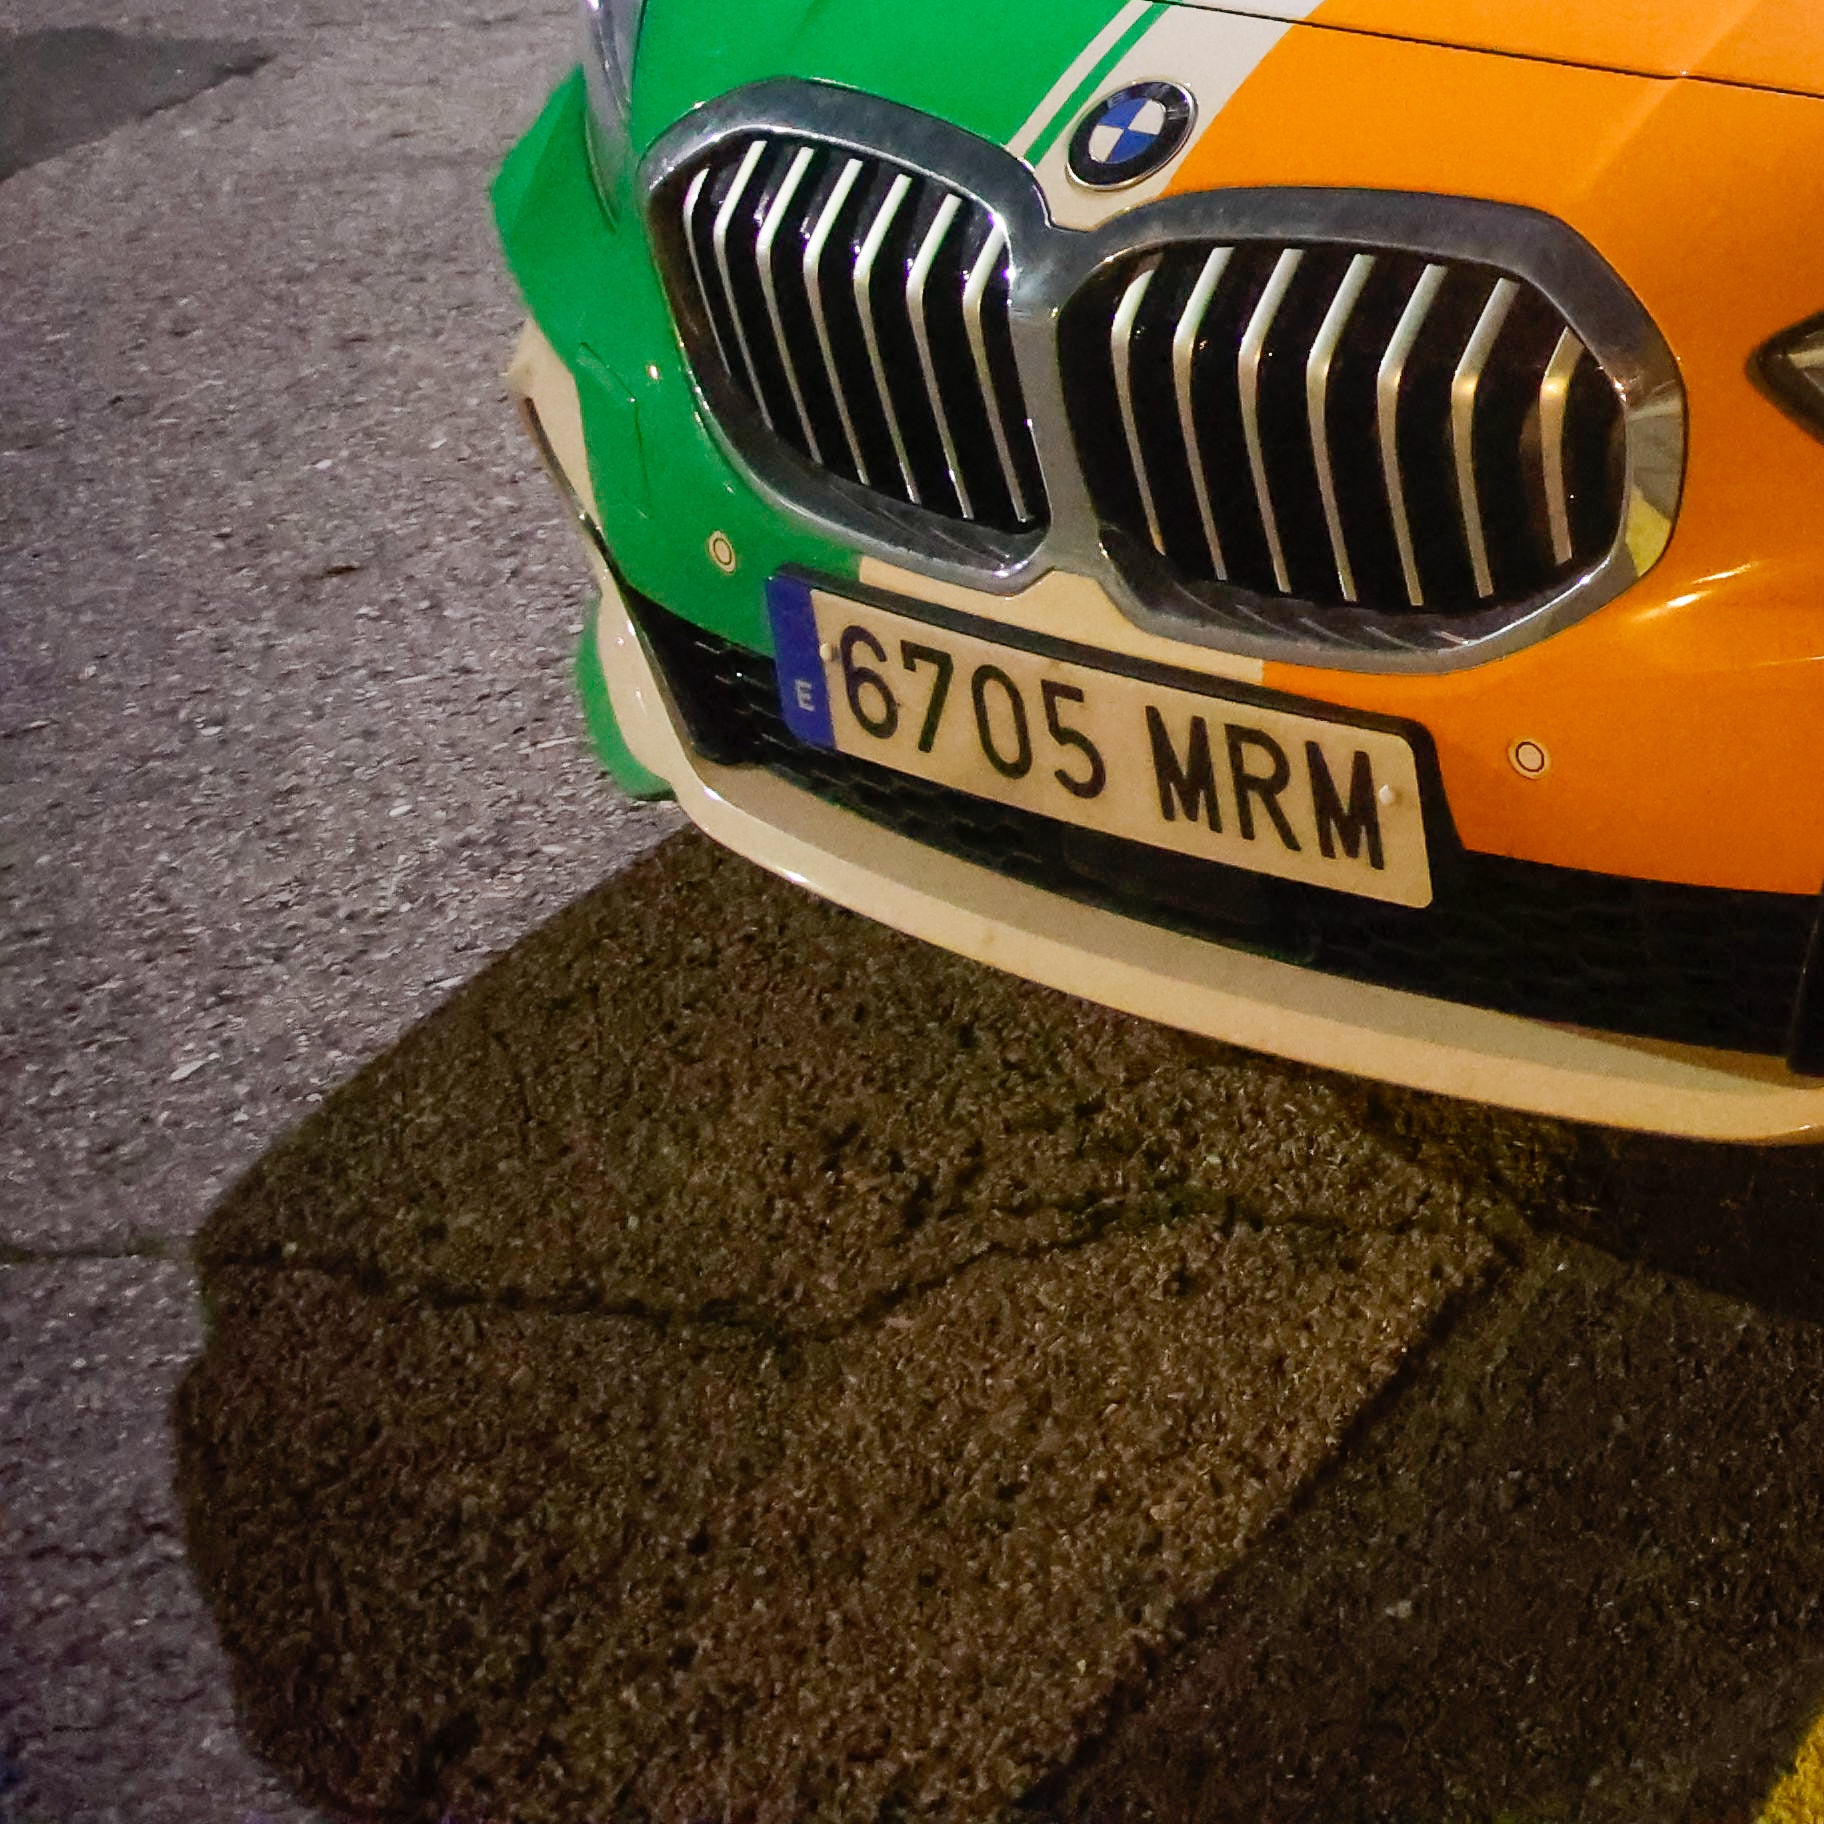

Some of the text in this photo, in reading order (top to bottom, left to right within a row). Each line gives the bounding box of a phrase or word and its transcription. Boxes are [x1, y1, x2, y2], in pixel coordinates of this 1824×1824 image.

[794, 679, 816, 712] E
[838, 625, 1386, 871] 6705 MRM
